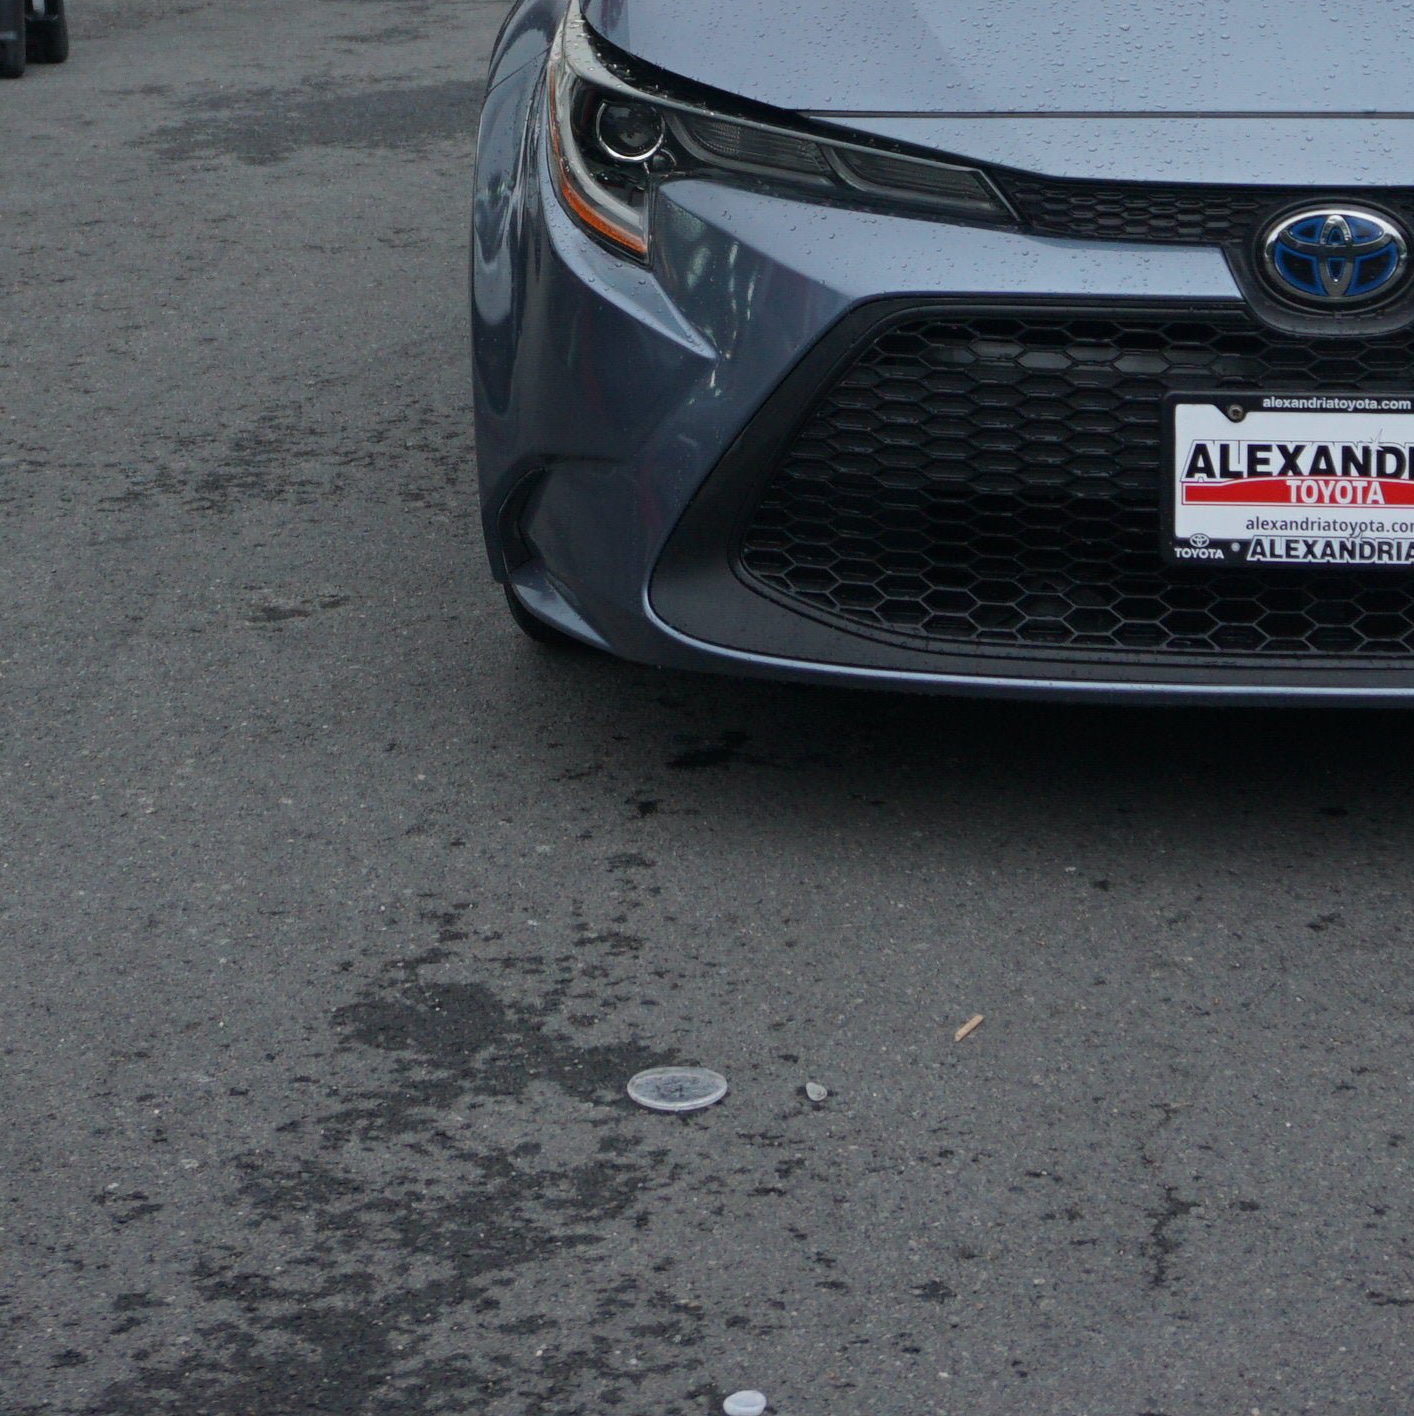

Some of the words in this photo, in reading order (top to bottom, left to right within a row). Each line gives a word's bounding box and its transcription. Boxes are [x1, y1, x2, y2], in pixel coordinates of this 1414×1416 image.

[1262, 397, 1412, 412] alexandriatoyota.com
[1286, 480, 1385, 505] TOYOTA
[1175, 547, 1225, 560] TOYOTA
